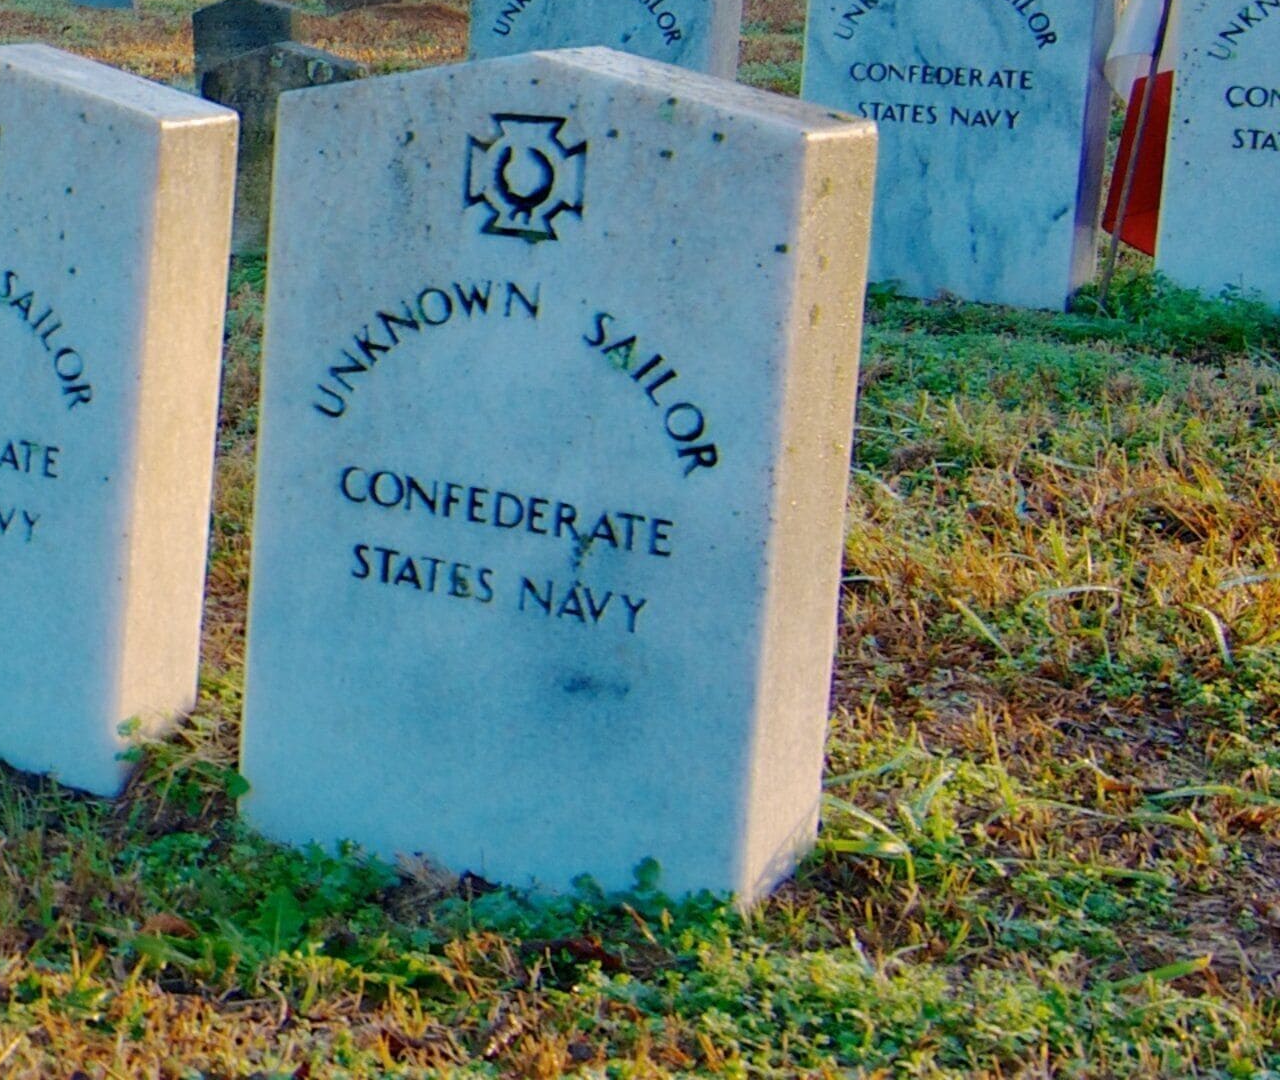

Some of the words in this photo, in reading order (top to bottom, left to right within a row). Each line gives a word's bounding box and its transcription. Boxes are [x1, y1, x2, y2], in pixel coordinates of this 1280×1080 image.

[849, 62, 1034, 90] CONFEDERATE
[858, 101, 938, 125] STATES
[950, 106, 1021, 129] NAVY
[1231, 127, 1280, 151] STA
[312, 279, 542, 420] UNKNOWN
[581, 310, 720, 479] SAILOR
[340, 465, 675, 558] CONFEDERATE
[350, 543, 495, 605] STATES
[517, 575, 648, 635] NAVY
